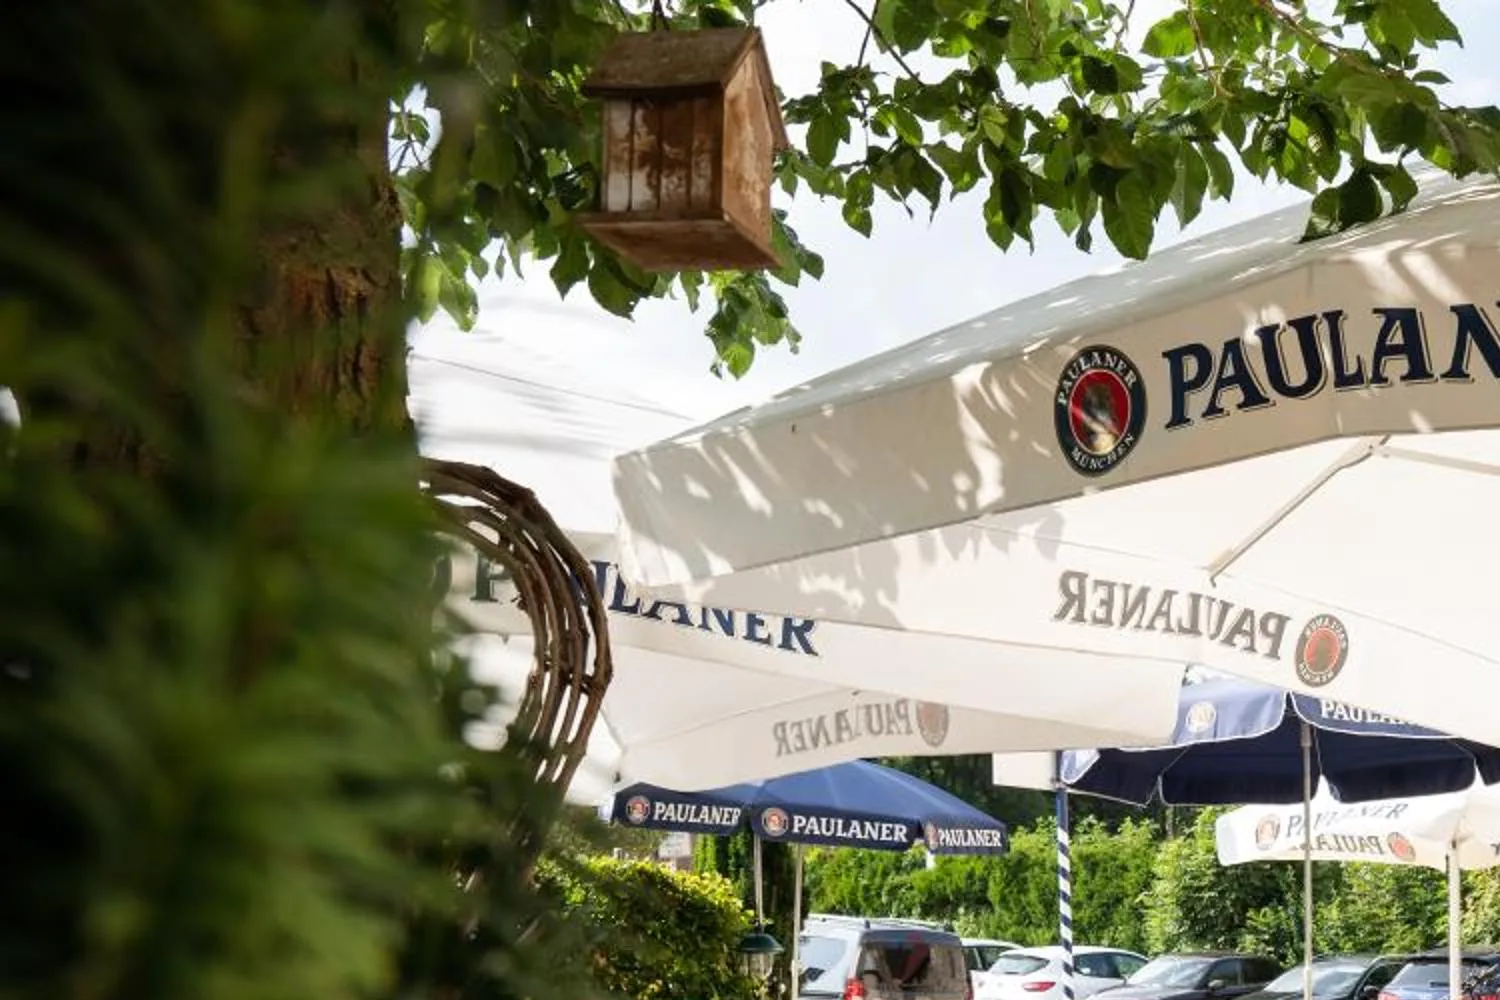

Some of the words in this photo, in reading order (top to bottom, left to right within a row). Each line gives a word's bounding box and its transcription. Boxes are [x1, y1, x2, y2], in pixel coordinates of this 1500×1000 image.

[1058, 351, 1137, 406] PAULANER
[653, 801, 742, 826] PAULANER
[792, 814, 908, 842] PAULANER
[938, 827, 1003, 847] PAULANER
